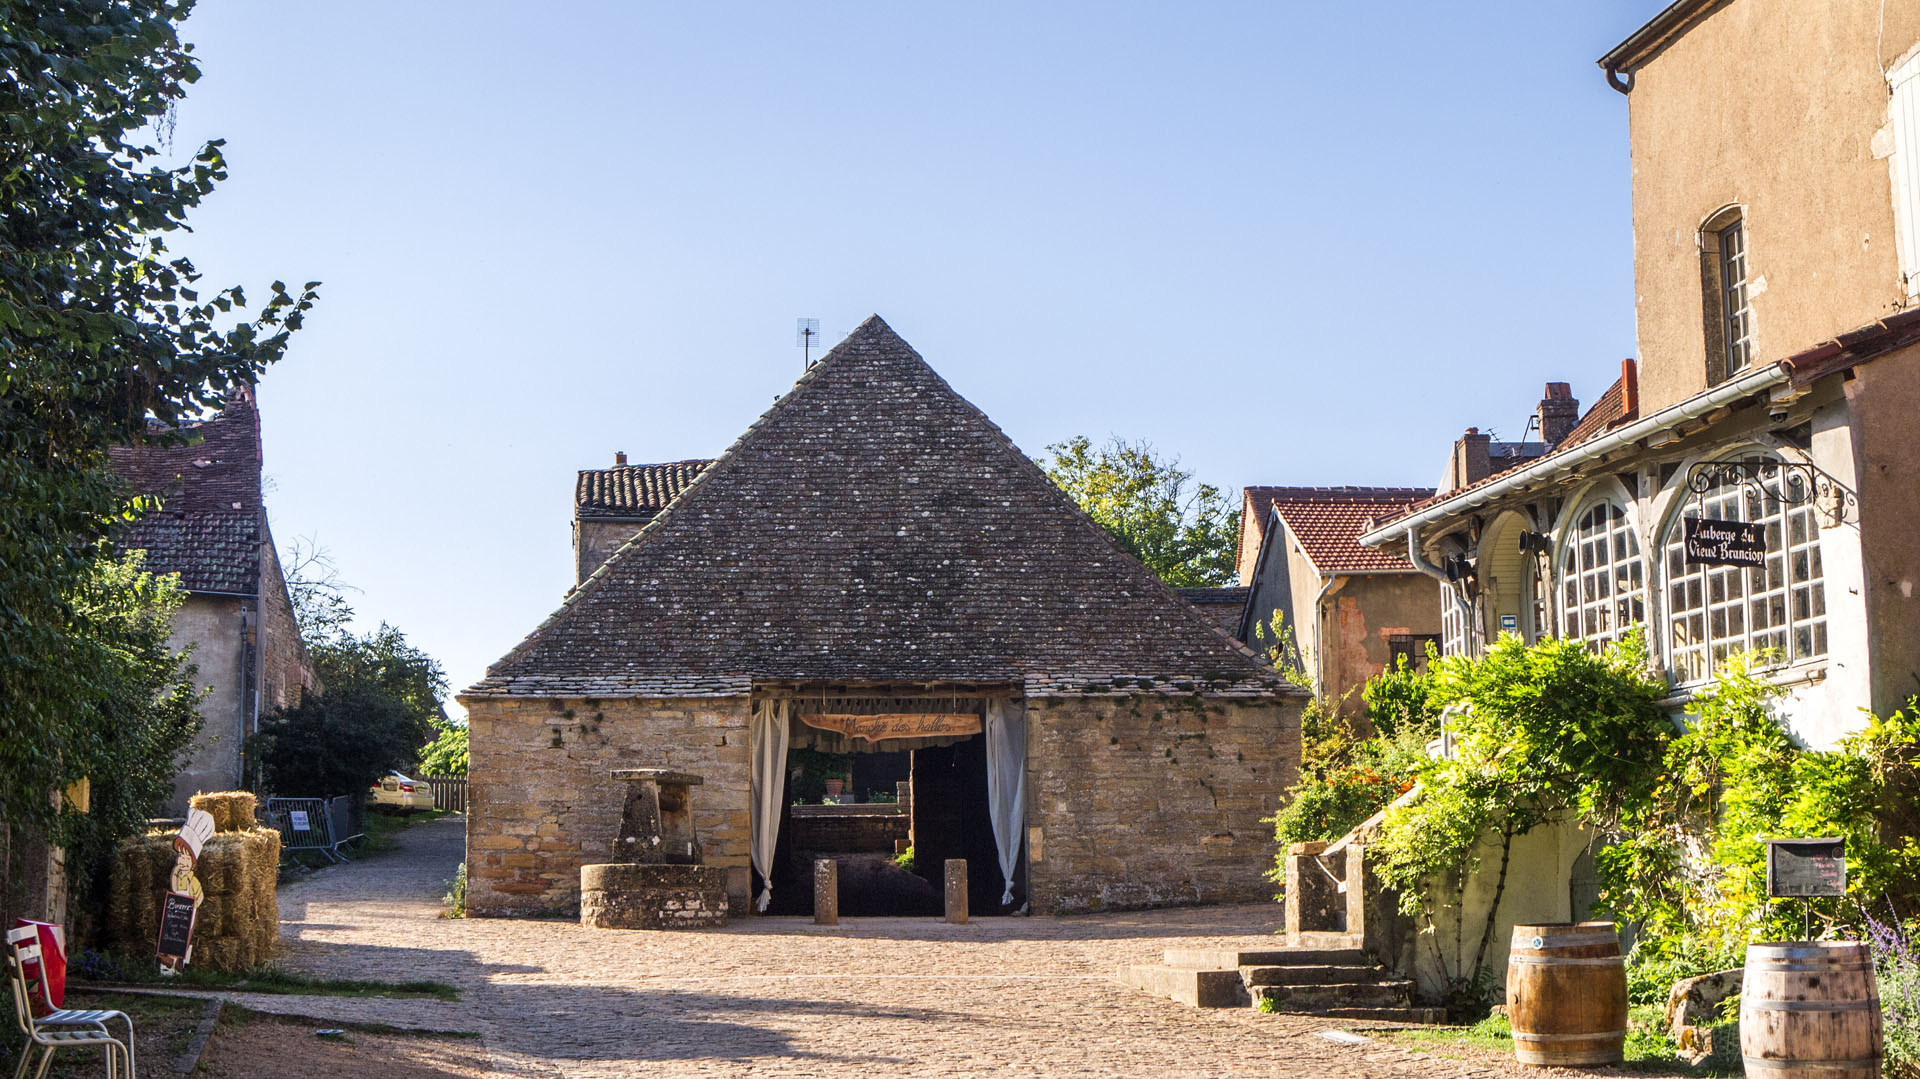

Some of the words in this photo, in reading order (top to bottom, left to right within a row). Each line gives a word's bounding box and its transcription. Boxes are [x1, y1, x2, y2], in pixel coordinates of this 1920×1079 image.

[1692, 523, 1736, 544] Auberge
[1741, 528, 1755, 543] du
[1718, 541, 1763, 564] Brancion
[891, 718, 911, 733] des
